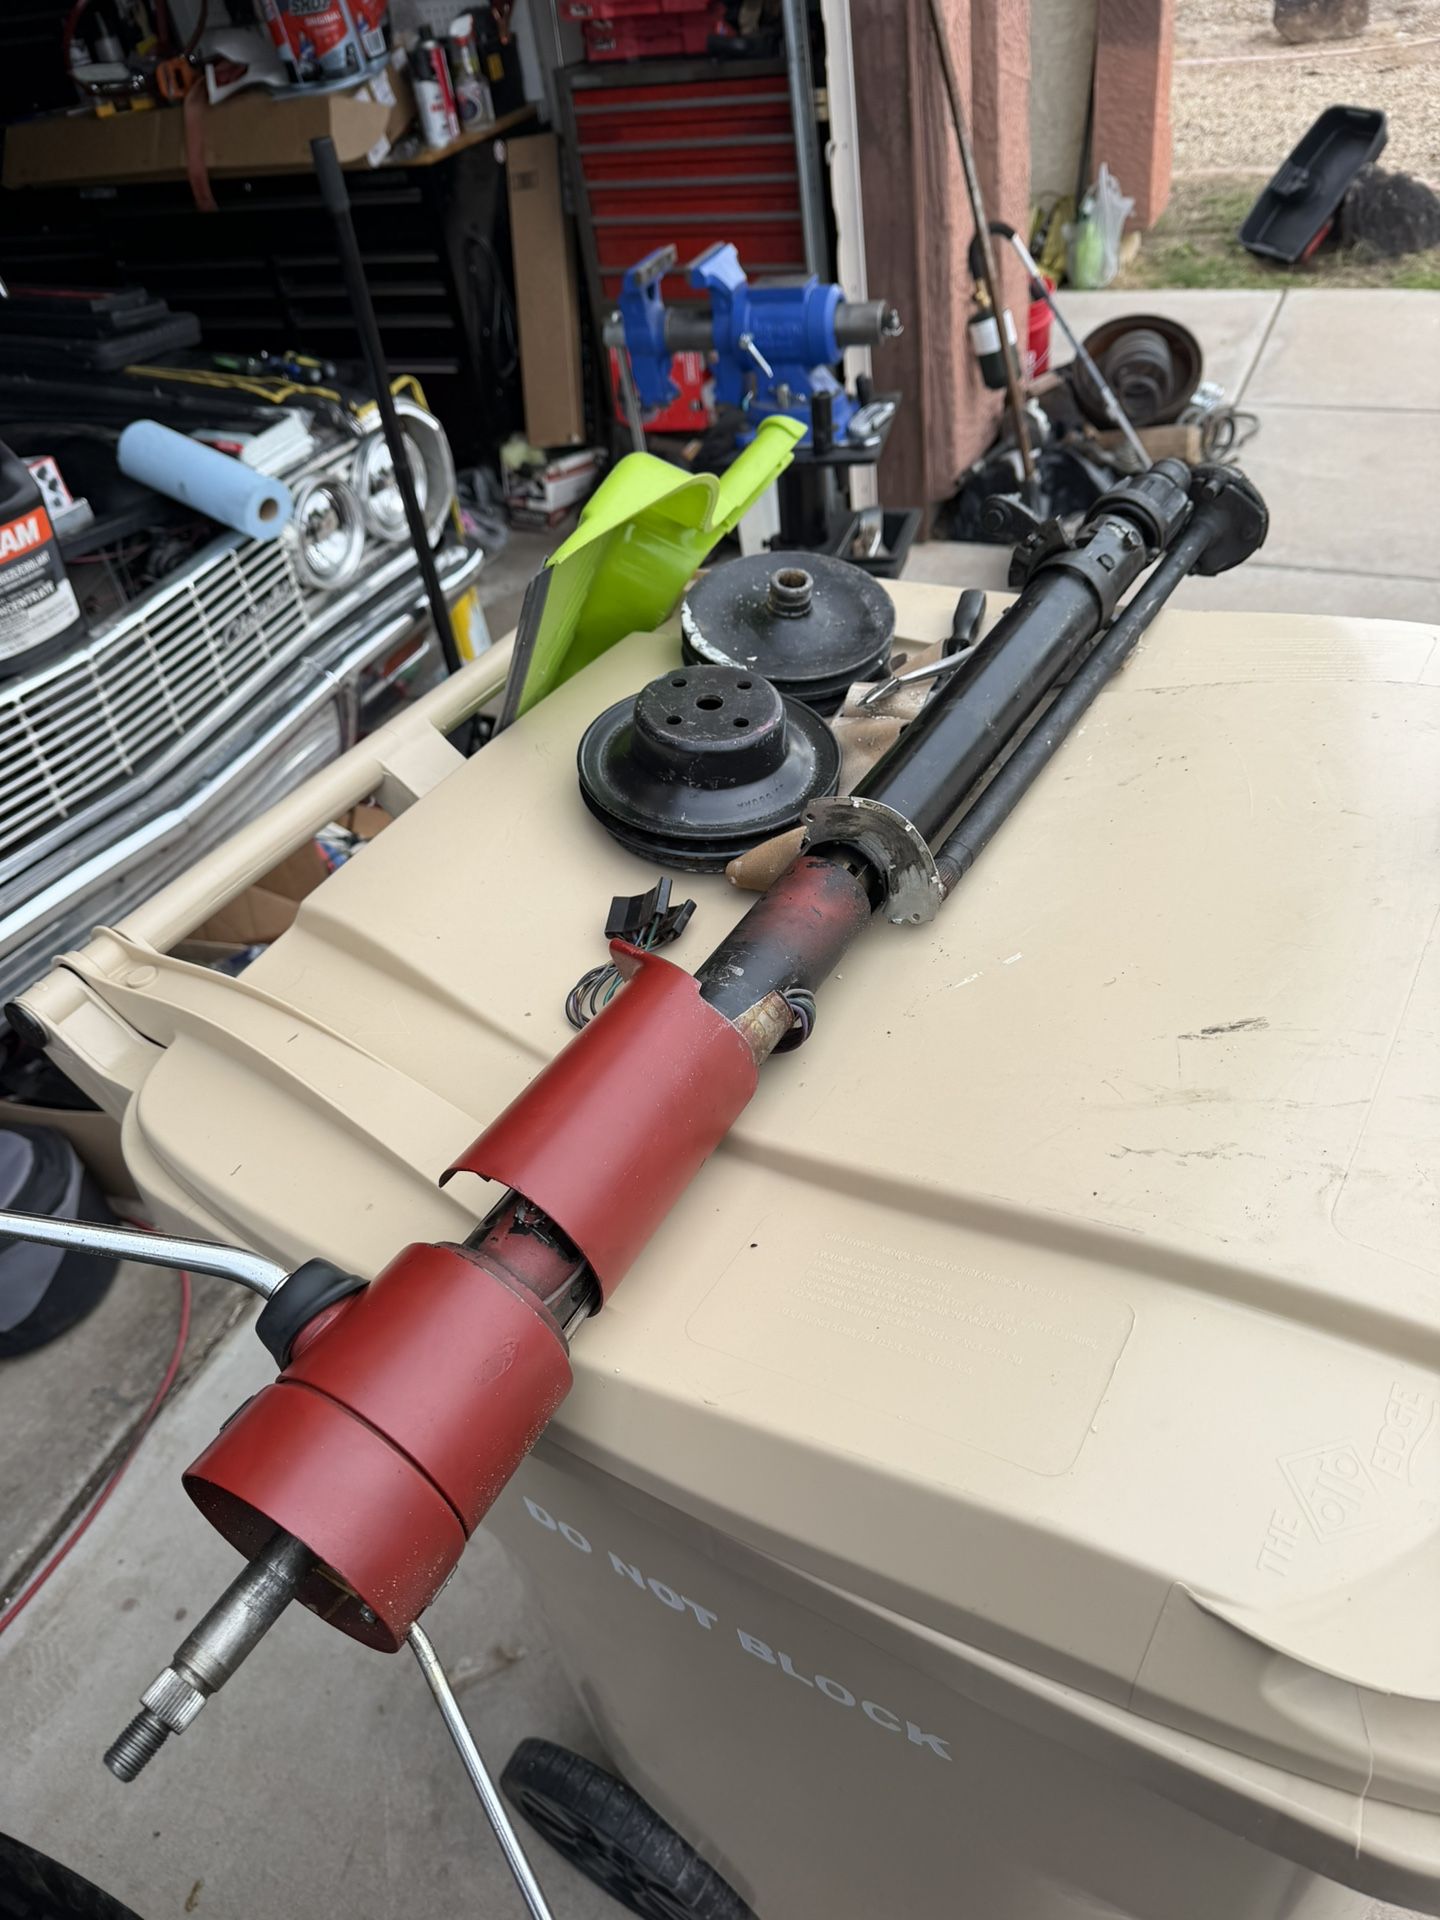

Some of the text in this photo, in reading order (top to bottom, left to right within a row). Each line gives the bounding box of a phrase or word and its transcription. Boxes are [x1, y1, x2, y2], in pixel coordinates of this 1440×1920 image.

[522, 1495, 953, 1762] DO NOT BLOCK
